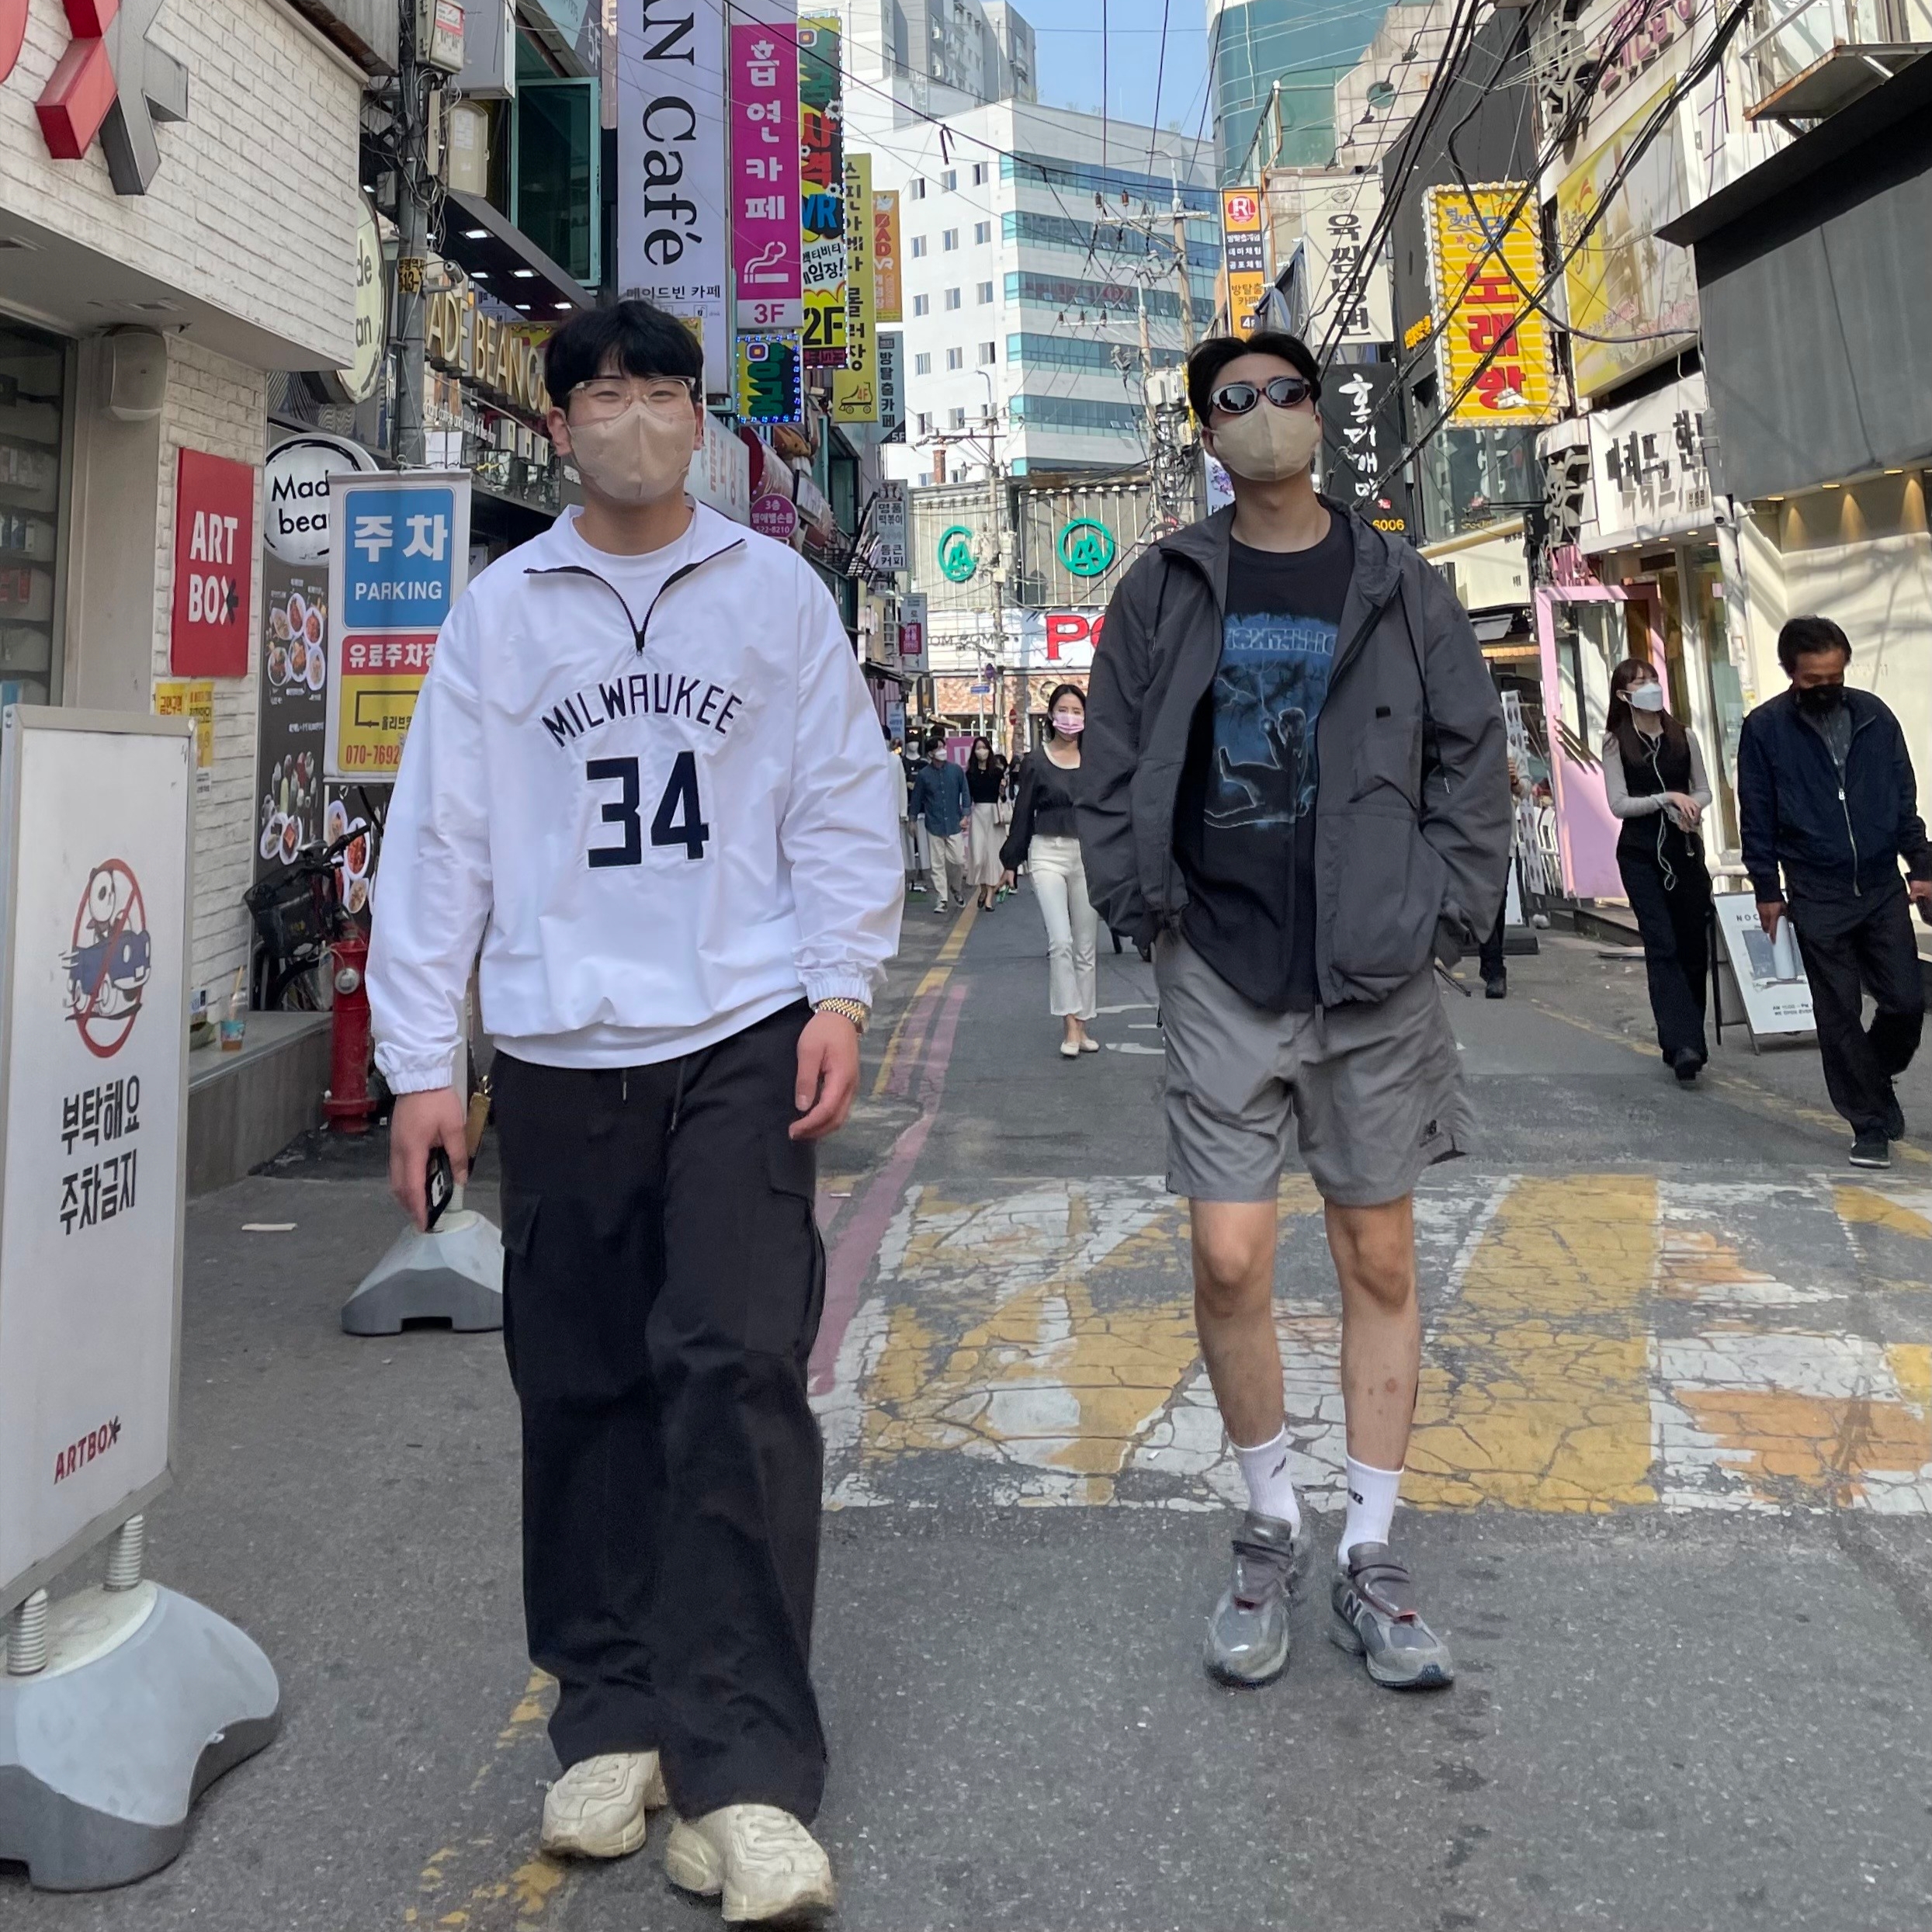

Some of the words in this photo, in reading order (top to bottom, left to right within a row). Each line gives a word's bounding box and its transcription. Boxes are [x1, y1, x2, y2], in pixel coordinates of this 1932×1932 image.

[587, 16, 601, 71] 5F
[745, 39, 786, 220] 흡연카페
[642, 95, 702, 265] Café
[802, 192, 838, 229] VR
[875, 213, 892, 257] BAD
[873, 257, 894, 270] VR
[1327, 213, 1371, 336] 육쌈냉면
[626, 285, 685, 300] 메이드빈
[691, 284, 720, 299] 카페
[754, 304, 786, 324] 3F
[803, 306, 845, 346] 2F
[1464, 262, 1527, 410] 노래방
[475, 307, 523, 405] BEAN
[857, 387, 869, 401] 4F
[879, 352, 897, 428] 방탈출카페
[892, 432, 905, 442] 5F
[189, 510, 239, 565] ART
[279, 508, 330, 535] bea
[354, 514, 449, 562] 주차
[880, 556, 904, 567] 커피
[188, 574, 239, 626] BOX
[355, 581, 442, 601] PARKING
[541, 672, 743, 749] MILWAUKEE
[586, 749, 709, 869] 34
[61, 1074, 140, 1156] 부탁해요
[60, 1148, 137, 1236] 주차금지
[54, 1415, 121, 1486] ARTBOX
